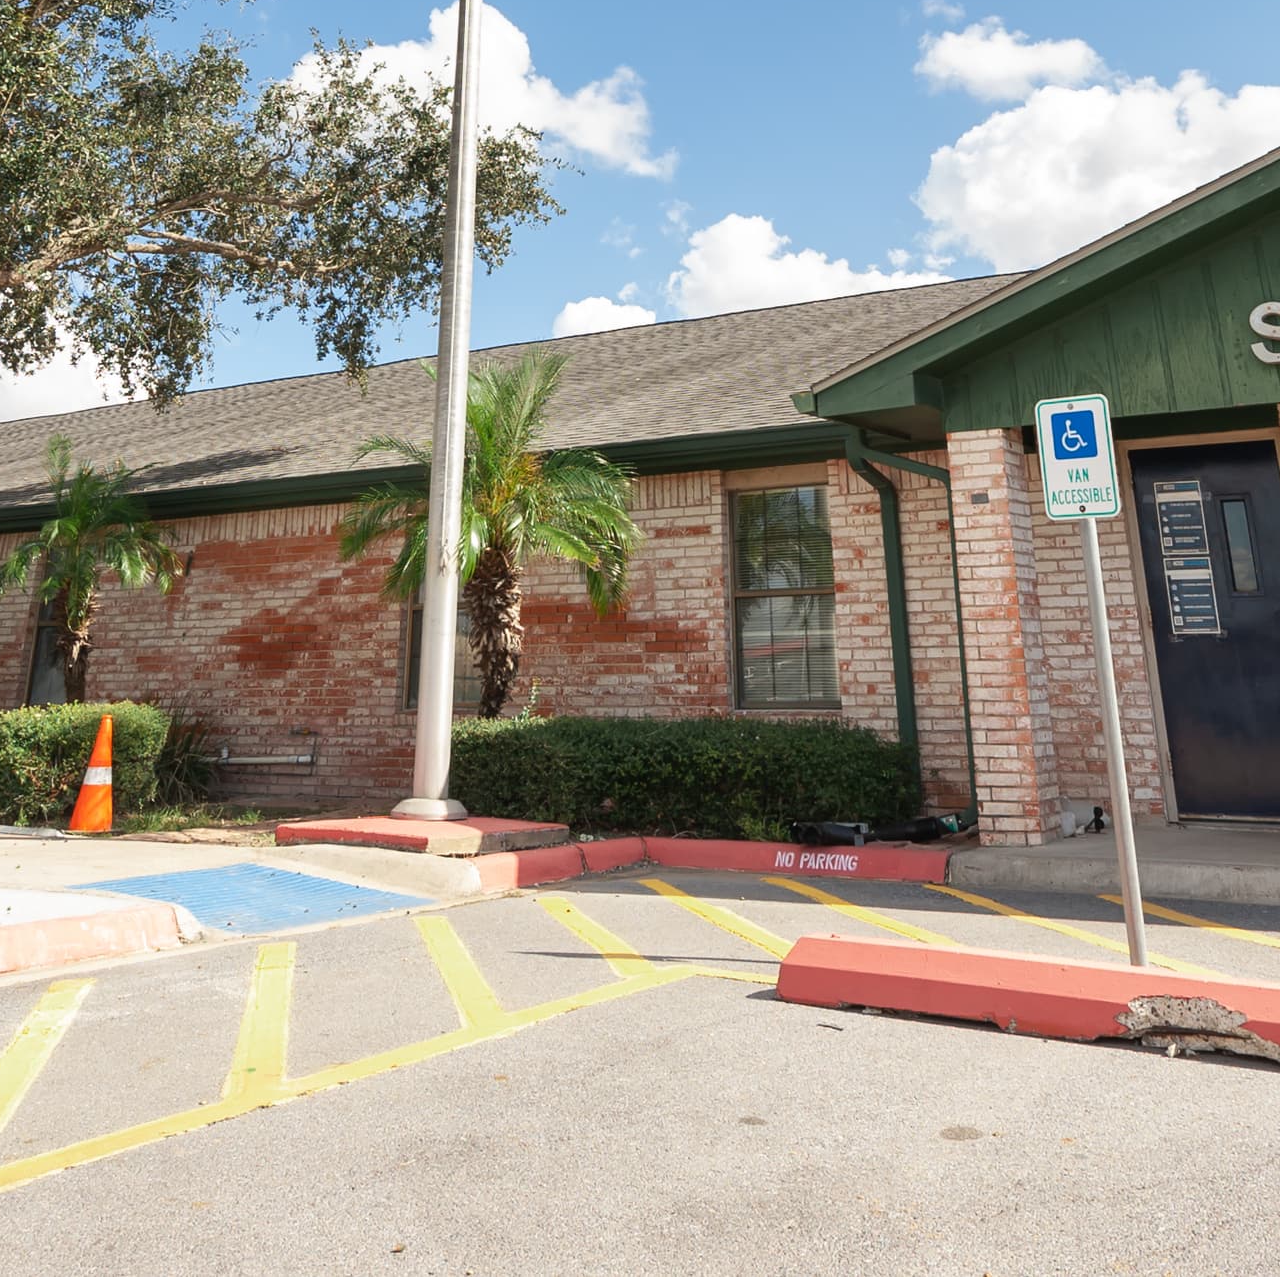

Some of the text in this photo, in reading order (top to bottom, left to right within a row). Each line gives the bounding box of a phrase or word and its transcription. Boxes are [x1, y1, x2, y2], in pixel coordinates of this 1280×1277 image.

[1067, 468, 1090, 483] VAN
[1051, 486, 1113, 505] ACCESSIBLE
[775, 851, 859, 871] NO PARKING
